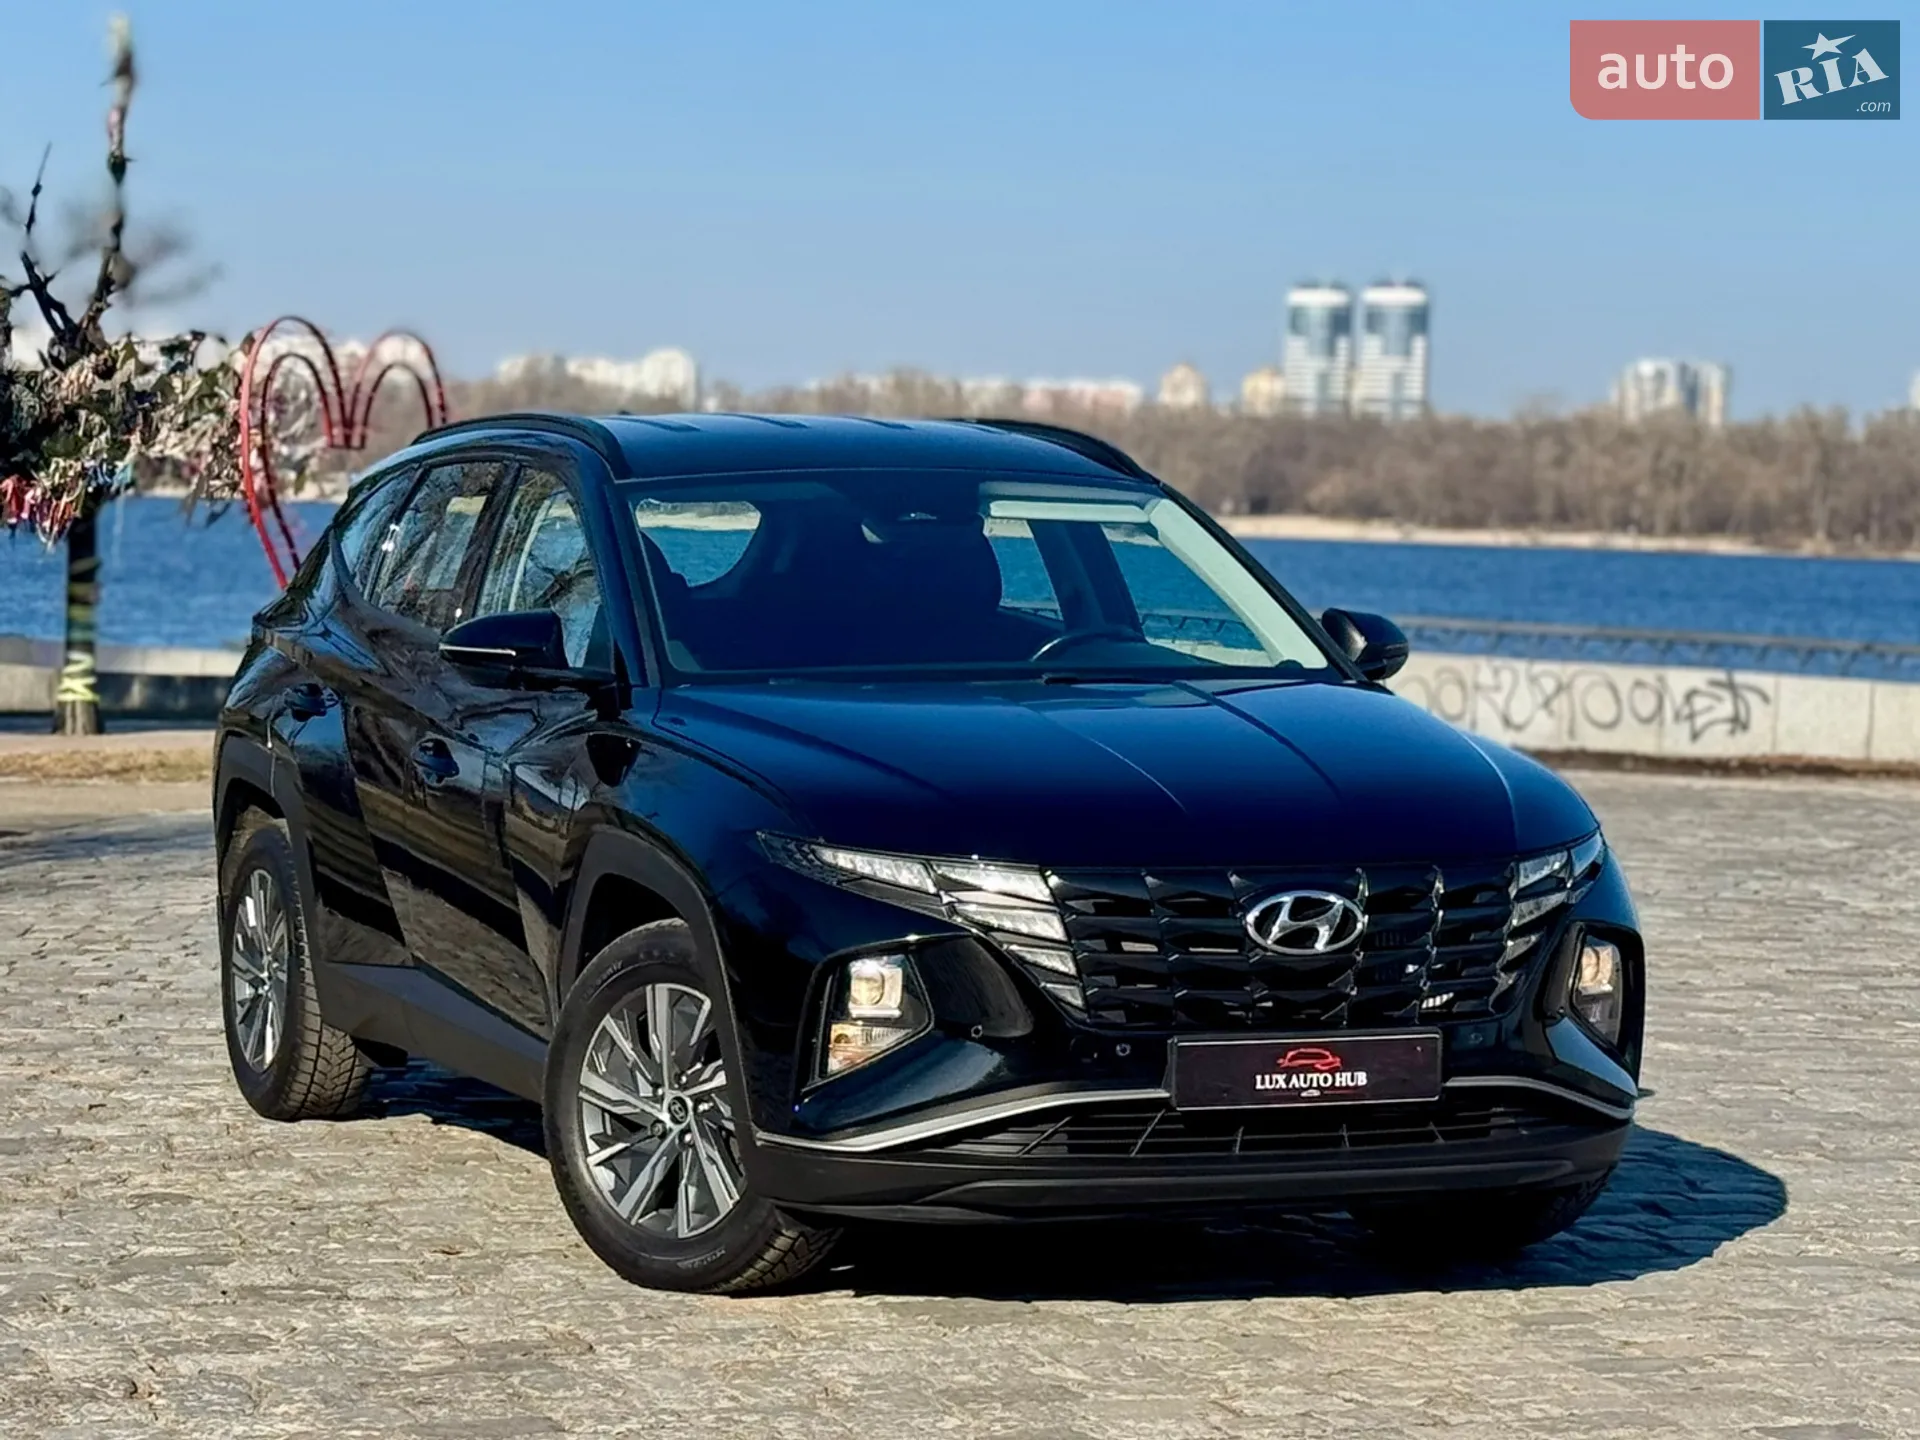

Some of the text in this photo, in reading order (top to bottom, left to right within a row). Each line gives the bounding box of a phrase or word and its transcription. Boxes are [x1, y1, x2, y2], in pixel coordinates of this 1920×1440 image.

[1255, 1071, 1367, 1089] LUX AUTO HUB
